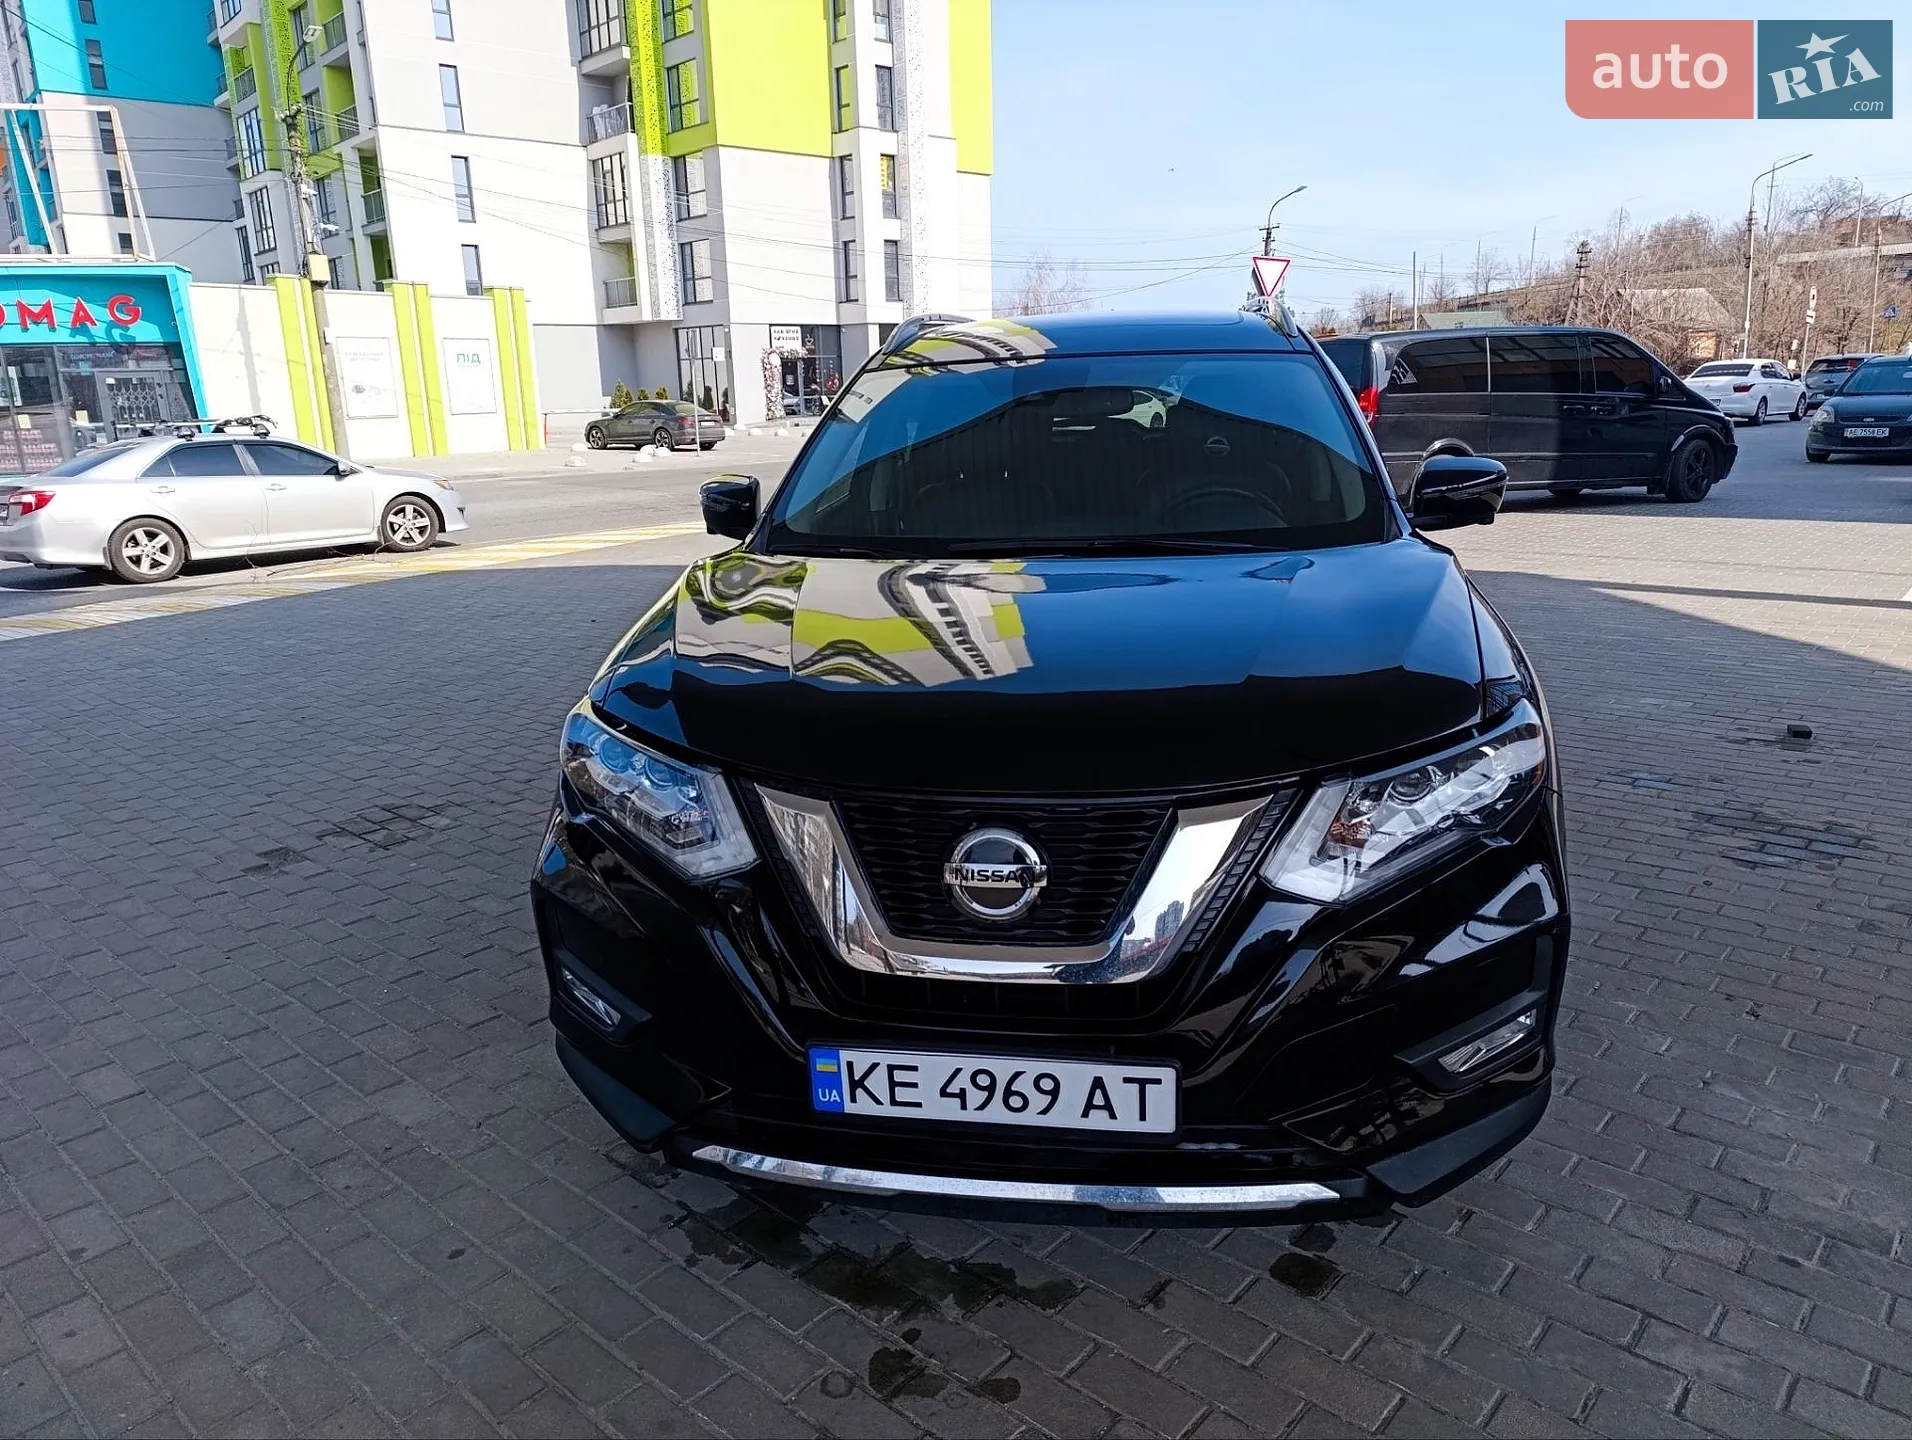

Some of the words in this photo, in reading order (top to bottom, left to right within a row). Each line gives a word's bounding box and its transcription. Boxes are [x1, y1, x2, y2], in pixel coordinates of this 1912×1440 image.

[954, 867, 1036, 885] NISSAN
[818, 1088, 841, 1103] UA
[845, 1060, 923, 1109] KE
[939, 1067, 1061, 1116] 4969
[1080, 1075, 1163, 1122] AT
